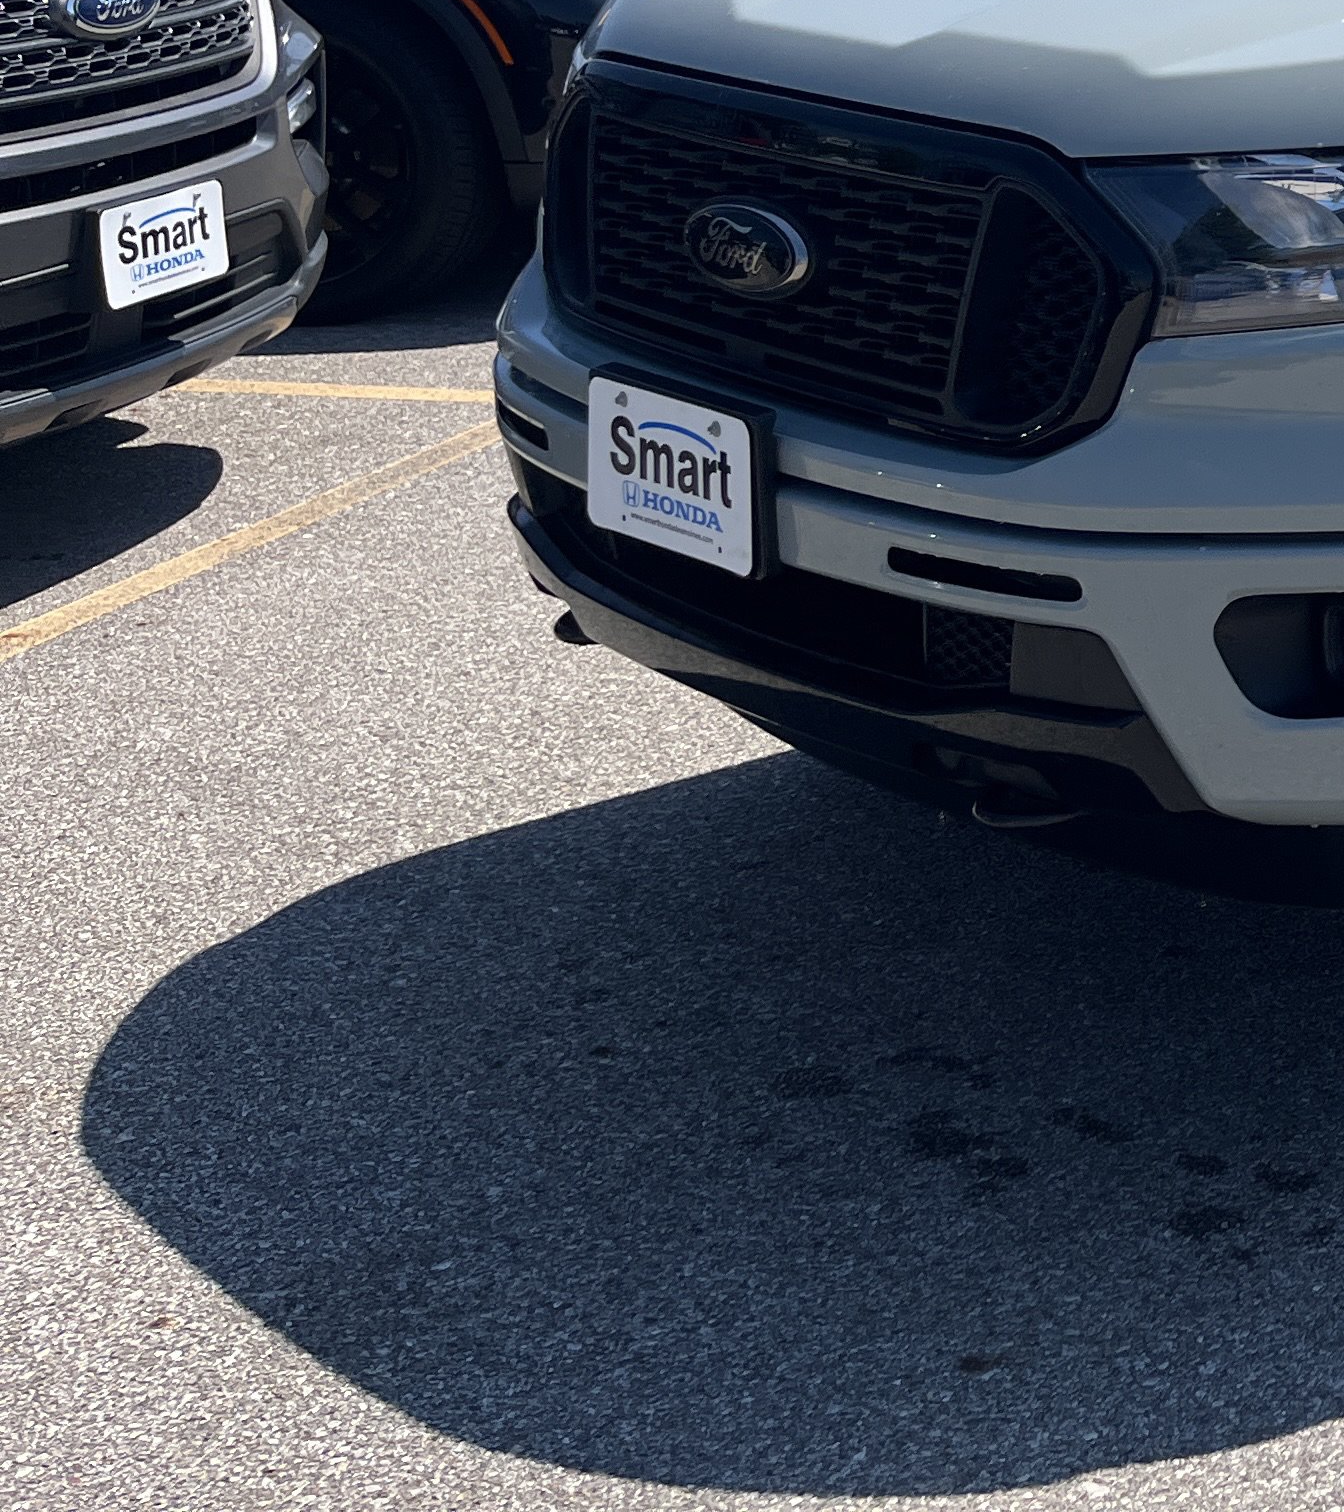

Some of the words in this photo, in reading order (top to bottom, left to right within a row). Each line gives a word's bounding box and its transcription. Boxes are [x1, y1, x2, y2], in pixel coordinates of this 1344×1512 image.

[117, 206, 210, 265] Smart
[146, 249, 205, 276] HONDA
[700, 216, 768, 275] Ford
[610, 415, 733, 509] Smart
[642, 488, 724, 533] HONDA
